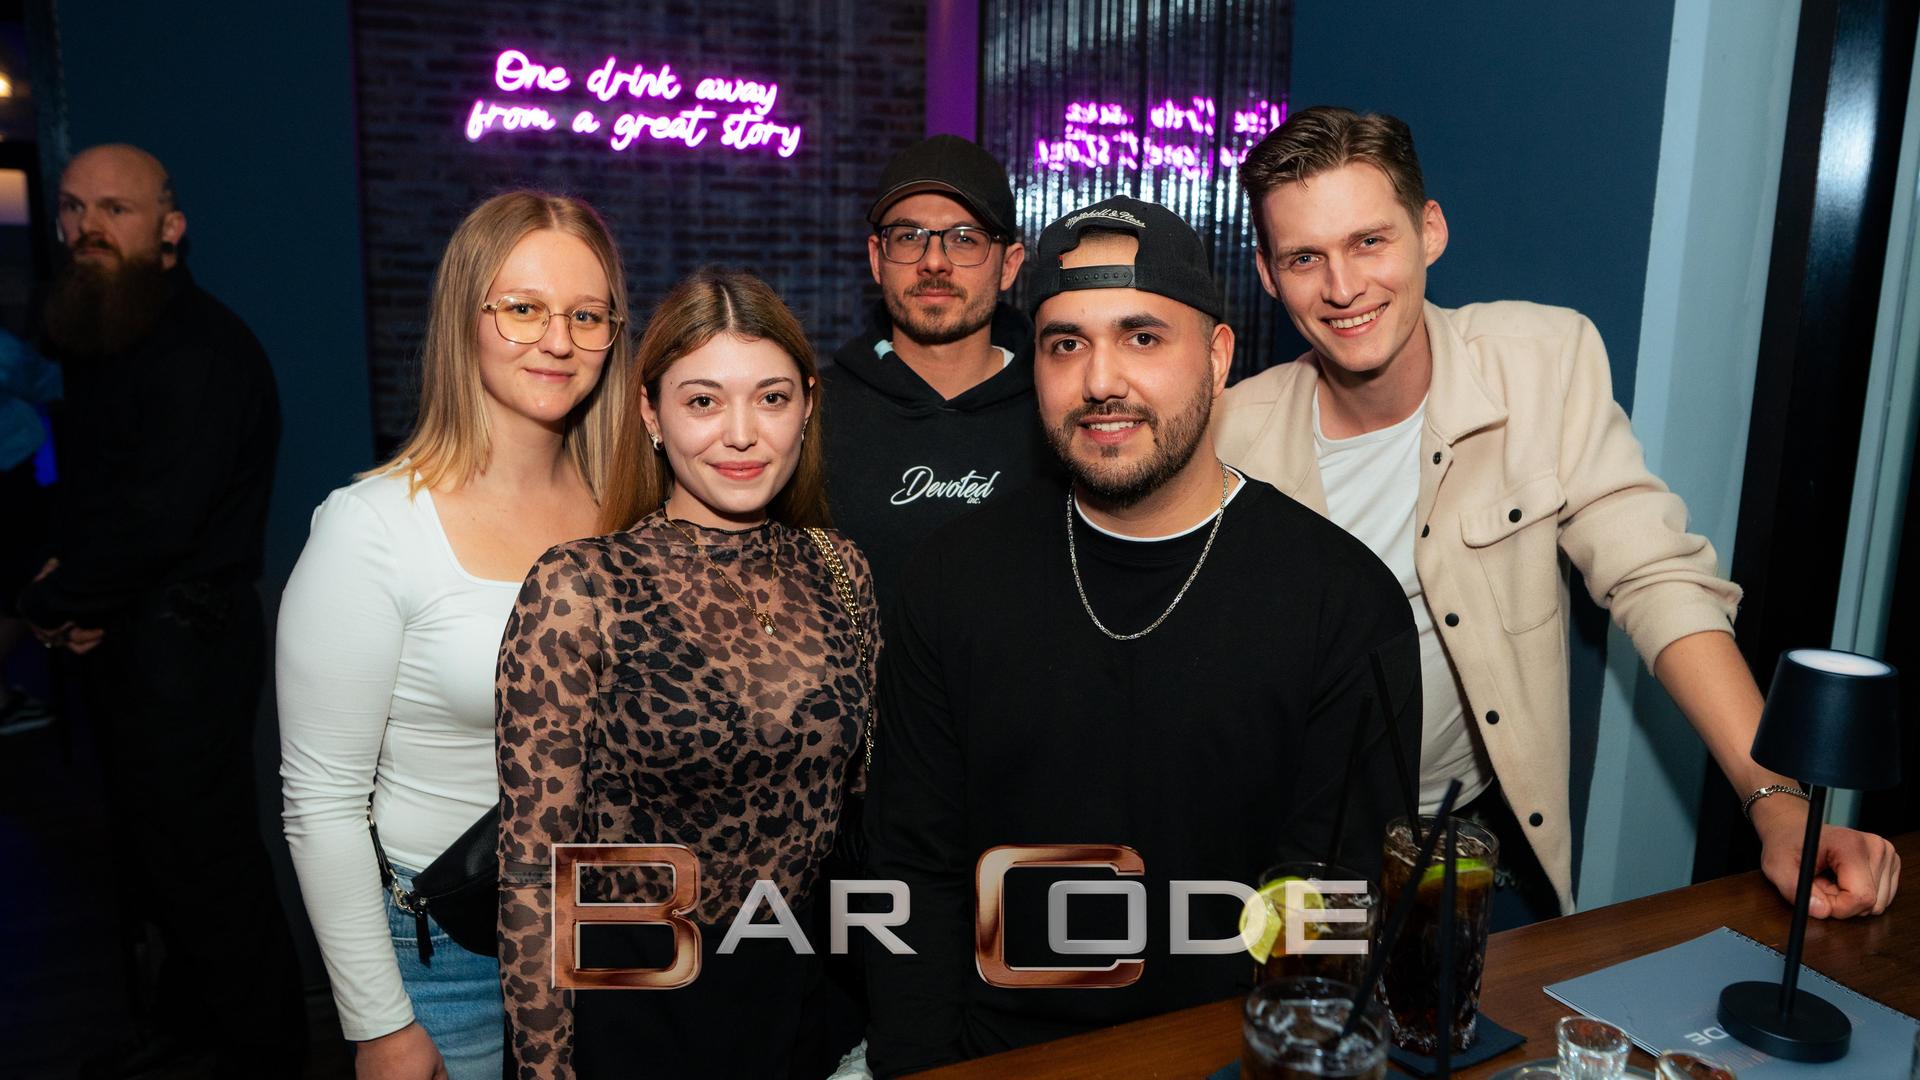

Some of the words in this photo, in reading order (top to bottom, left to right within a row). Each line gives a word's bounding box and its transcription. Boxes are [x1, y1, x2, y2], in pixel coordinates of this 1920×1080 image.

[495, 49, 570, 92] One
[586, 56, 682, 101] drink
[695, 77, 777, 115] away
[466, 99, 556, 141] from
[572, 110, 600, 133] a
[610, 104, 717, 151] great
[720, 108, 801, 157] story
[890, 465, 1001, 505] Devoted
